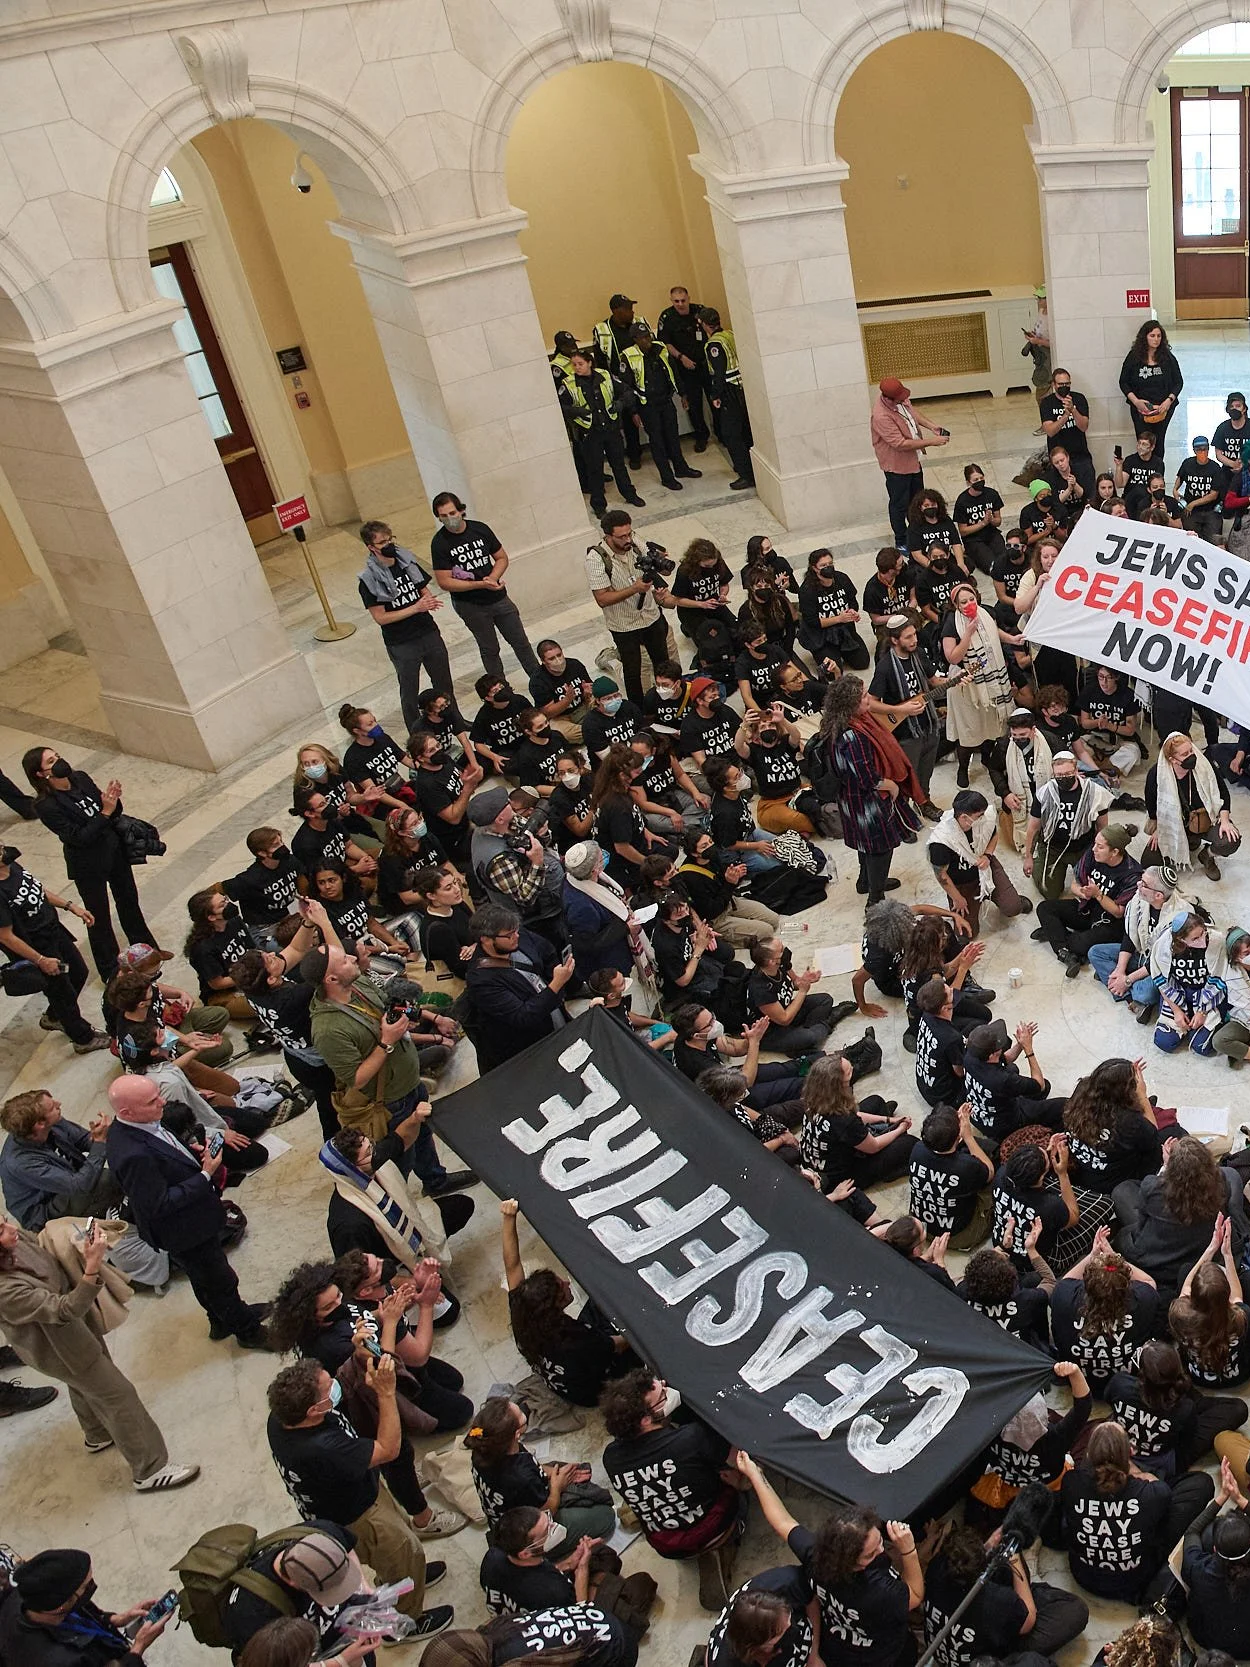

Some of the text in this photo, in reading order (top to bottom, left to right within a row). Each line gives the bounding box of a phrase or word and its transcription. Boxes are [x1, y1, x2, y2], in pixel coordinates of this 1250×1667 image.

[1128, 294, 1148, 304] EXIT
[1096, 534, 1207, 593] JEWS
[822, 598, 845, 611] OUR
[1101, 622, 1223, 695] NOW!
[1090, 702, 1124, 714] NOT IN
[605, 719, 635, 737] NOT IN
[647, 773, 663, 787] NOT
[264, 871, 297, 895] NOT IN
[273, 882, 297, 899] OUR
[1172, 958, 1195, 968] NOT
[910, 1162, 960, 1187] JEWS
[912, 1176, 949, 1197] SAY
[993, 1188, 1036, 1220] JEWS
[1079, 1332, 1126, 1347] SAY
[1070, 1344, 1133, 1359] CEASE
[1080, 1356, 1124, 1368] FIRE
[1114, 1401, 1172, 1433] JEWS
[612, 1459, 677, 1491] JEWS
[624, 1476, 673, 1503] SAY
[1074, 1498, 1140, 1517] JEWS
[1082, 1518, 1131, 1536] SAY
[1077, 1532, 1141, 1550] CEASE
[1086, 1548, 1132, 1561] FIRE
